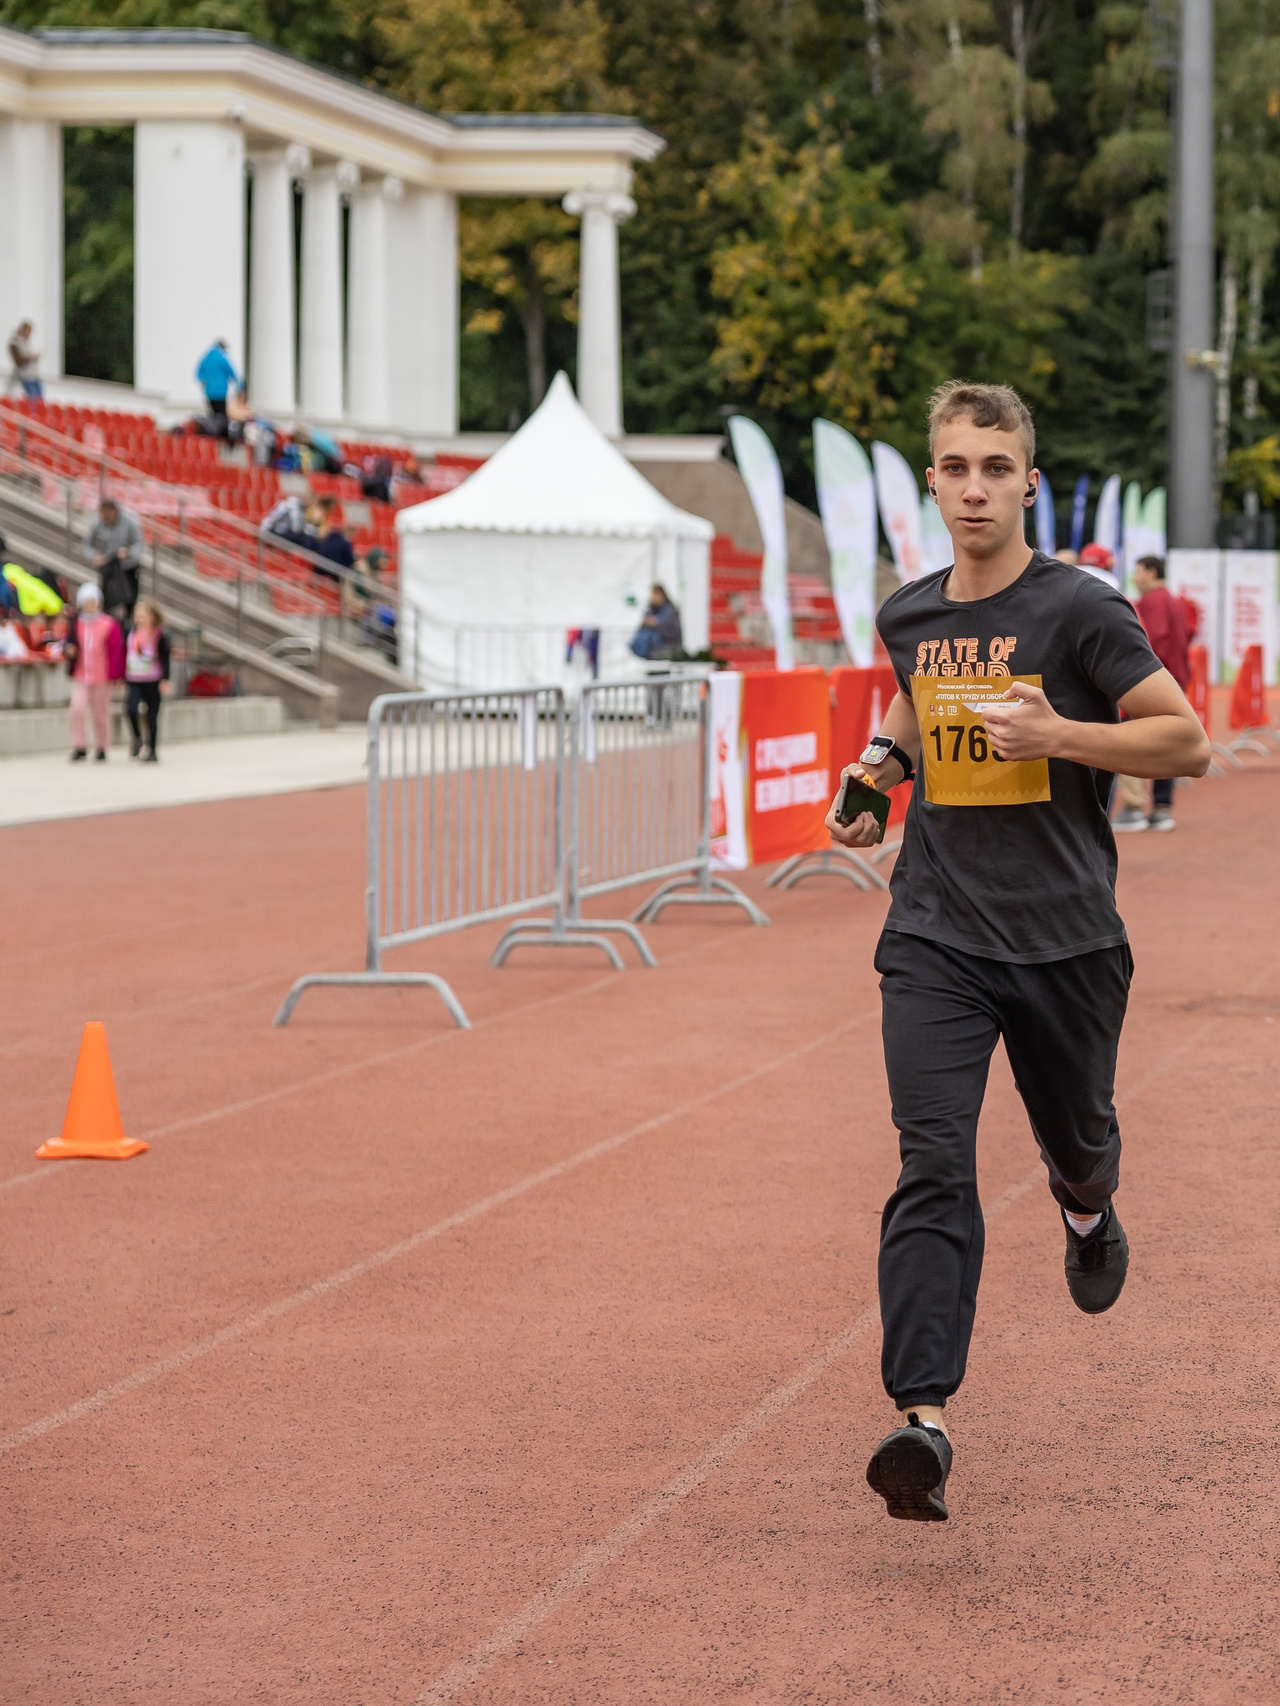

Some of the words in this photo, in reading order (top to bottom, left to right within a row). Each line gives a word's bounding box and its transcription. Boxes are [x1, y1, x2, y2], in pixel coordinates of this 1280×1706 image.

[916, 638, 979, 665] STATE
[988, 636, 1017, 661] OF
[961, 693, 980, 701] ТРУДУ
[929, 724, 1009, 763] 176
